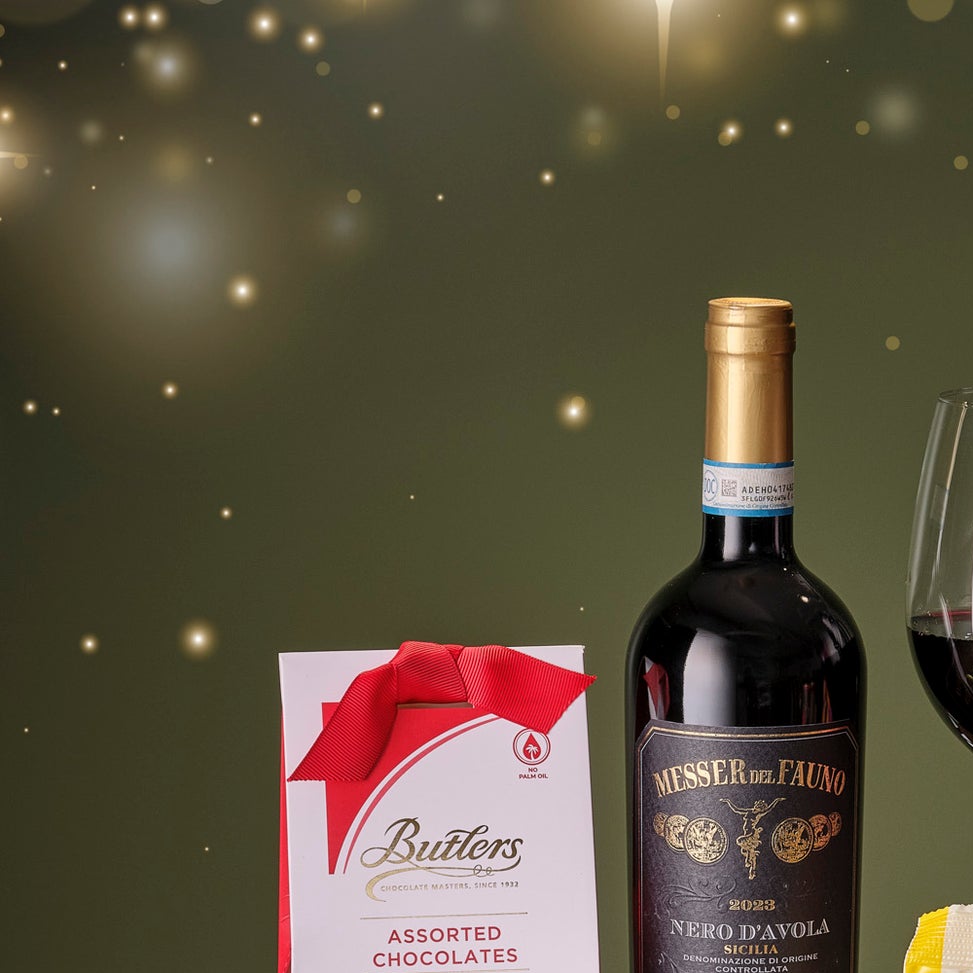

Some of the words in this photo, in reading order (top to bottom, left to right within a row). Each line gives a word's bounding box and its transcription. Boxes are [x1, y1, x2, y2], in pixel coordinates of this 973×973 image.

[653, 758, 748, 798] MESSER
[750, 770, 776, 784] DEL
[777, 759, 846, 797] FAUNO
[360, 817, 523, 878] Butlers
[380, 884, 429, 892] CHOCOLATE
[474, 881, 498, 889] SINCE
[729, 899, 776, 911] 2023
[387, 926, 501, 944] ASSORTED
[670, 918, 733, 941] NERO
[738, 918, 830, 941] D'AVOLA
[724, 944, 778, 955] SICILIA
[373, 948, 518, 967] CHOCOLATES
[683, 954, 766, 965] DENOMINAZIONE
[781, 953, 818, 964] ORIGINE
[715, 965, 788, 973] CONTROLLATA
